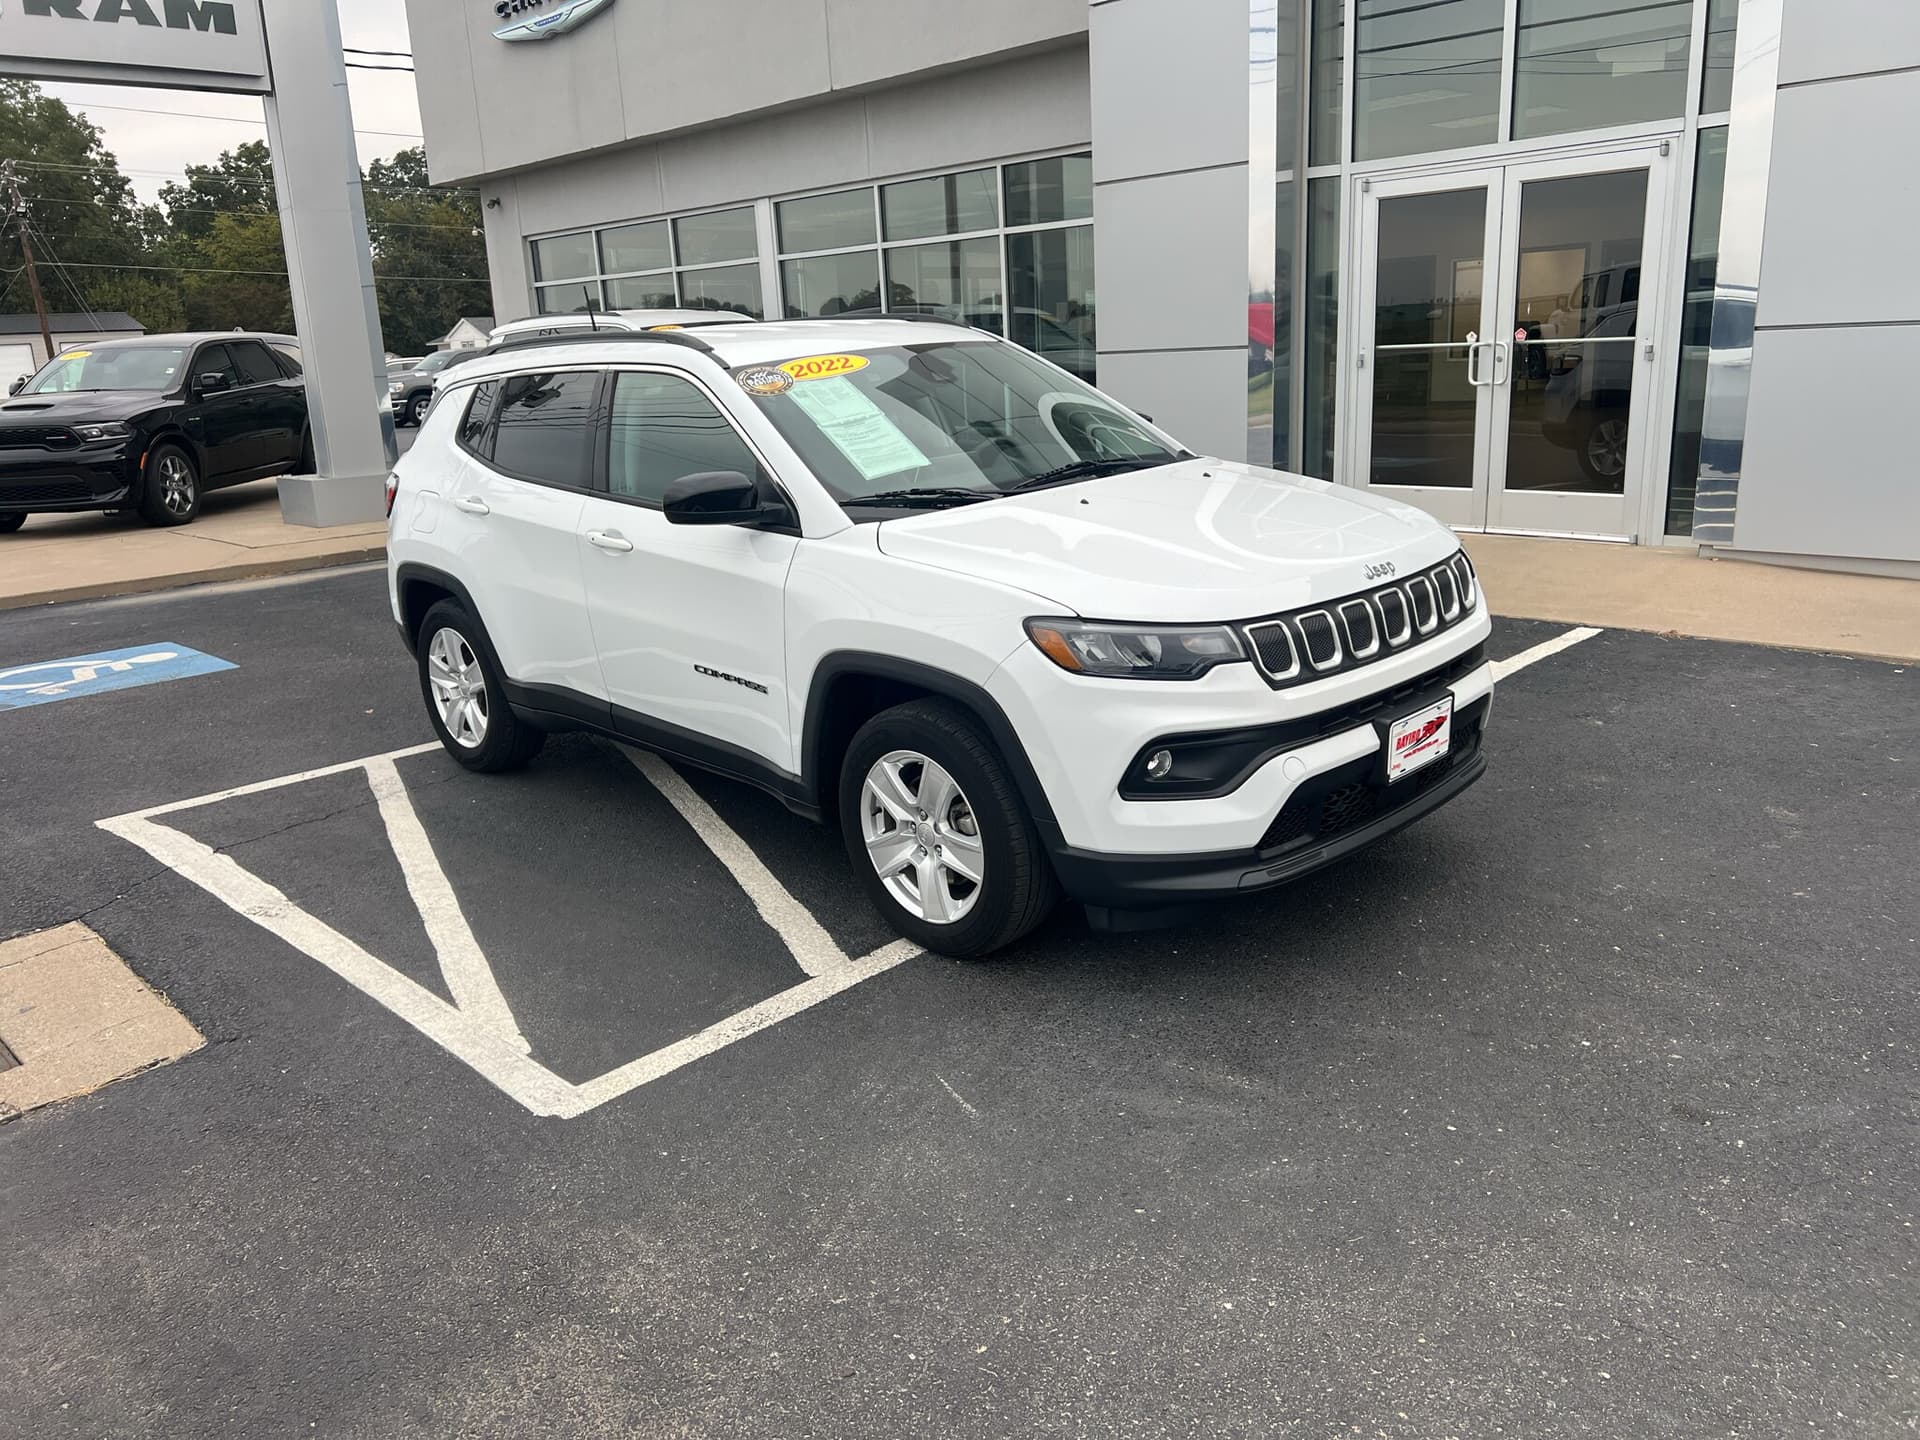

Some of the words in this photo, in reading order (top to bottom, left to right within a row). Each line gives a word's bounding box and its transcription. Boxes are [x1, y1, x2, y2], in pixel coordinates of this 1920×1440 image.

[23, 0, 238, 35] RAM
[790, 356, 854, 378] 2022
[1363, 561, 1395, 580] Jeep
[694, 664, 768, 694] COMPASS
